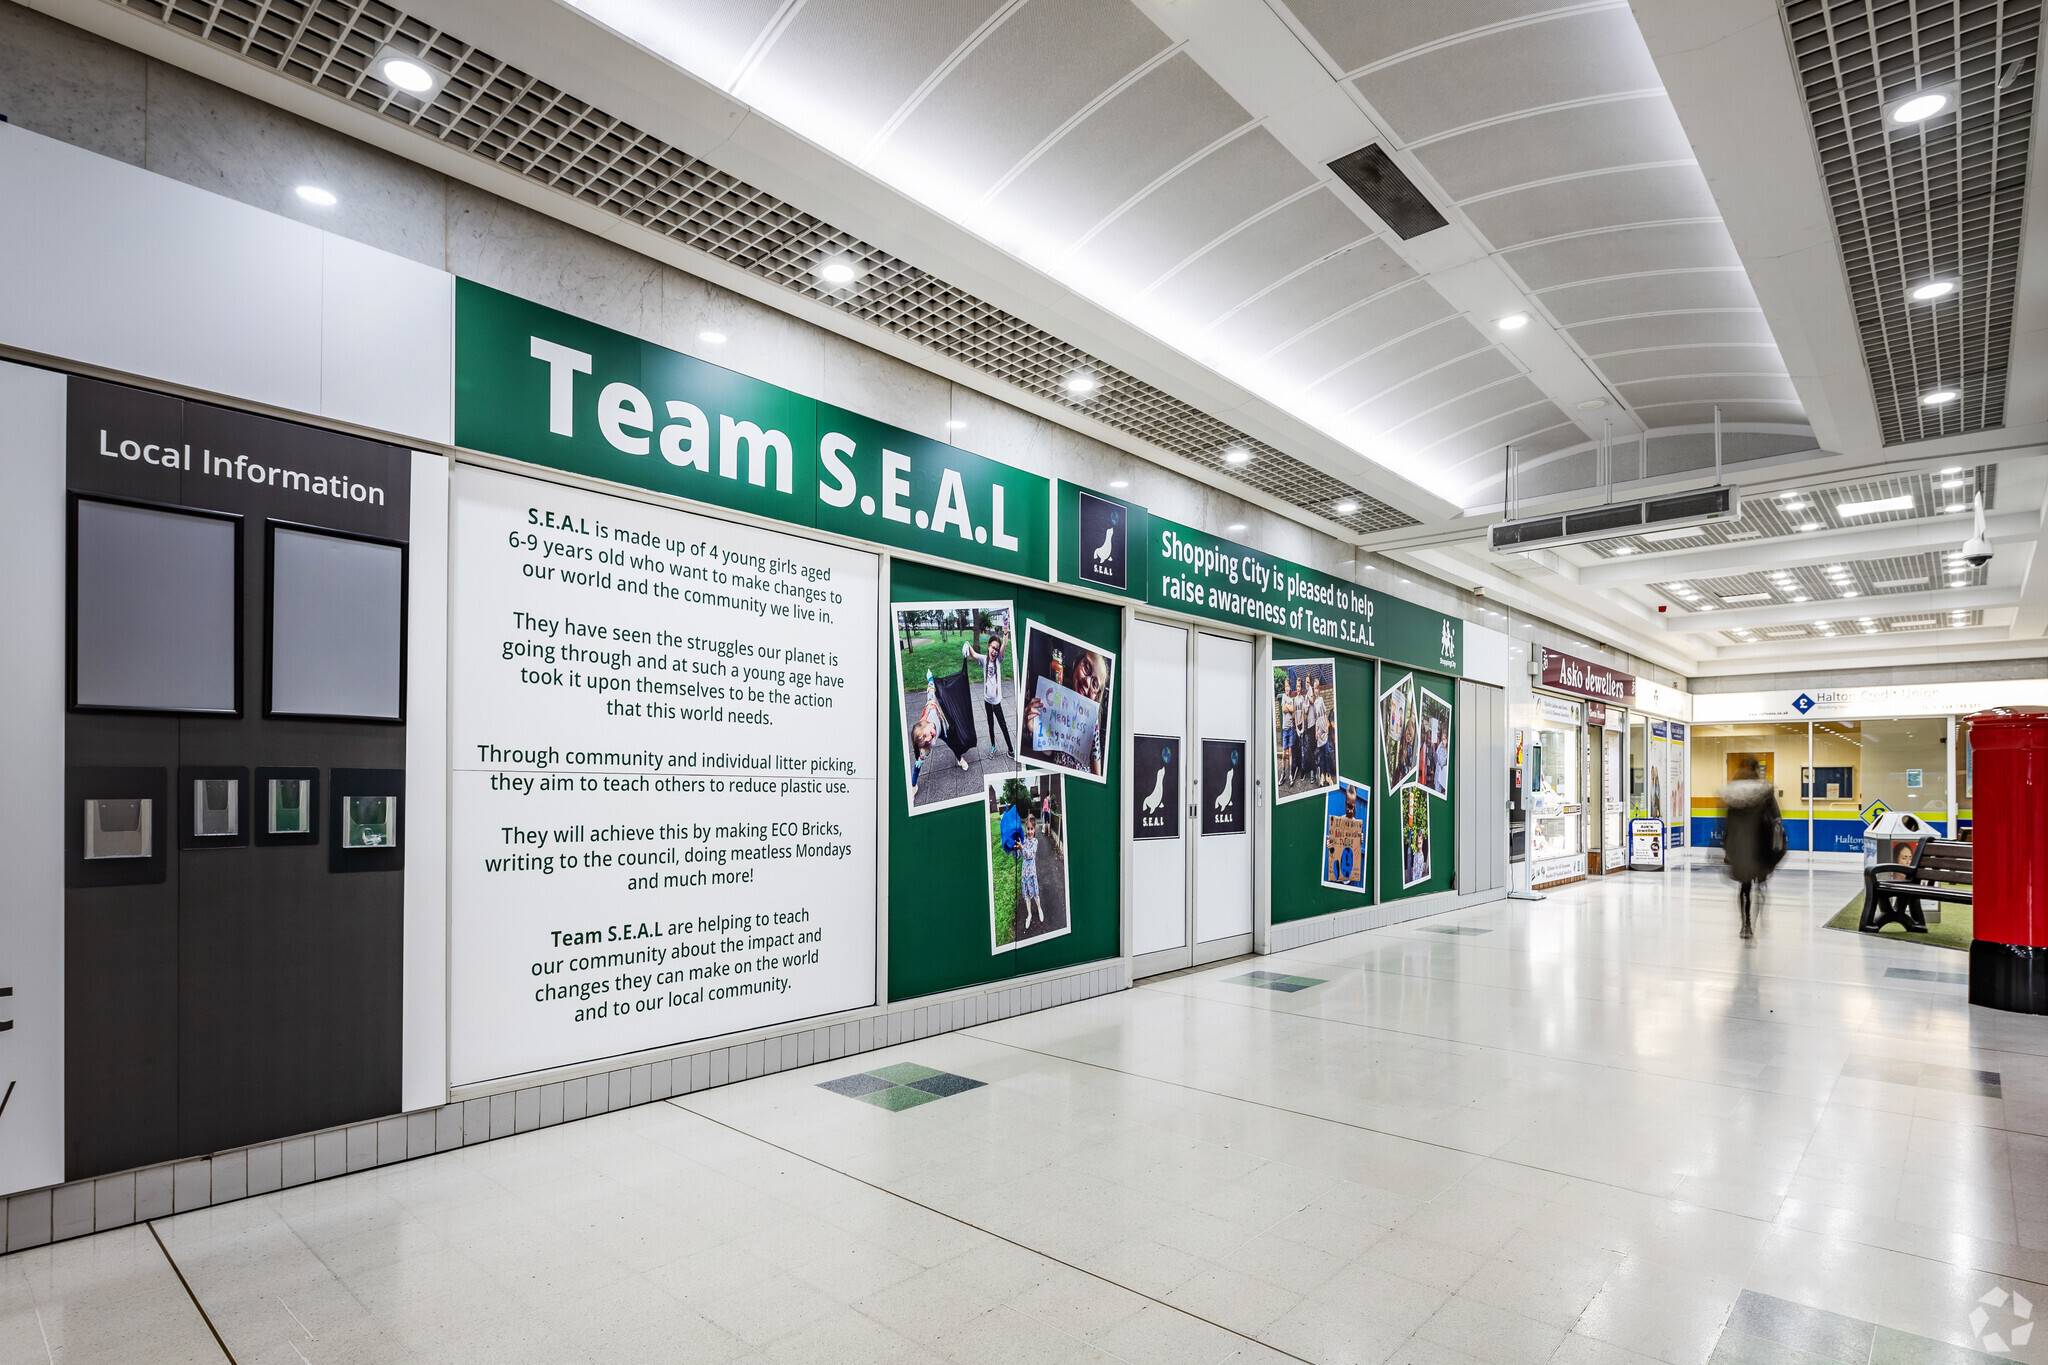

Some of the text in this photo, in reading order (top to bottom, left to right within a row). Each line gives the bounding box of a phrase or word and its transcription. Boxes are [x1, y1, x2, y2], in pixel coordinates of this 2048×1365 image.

[528, 333, 1021, 555] Team S.E.A.L
[99, 429, 385, 506] Local Information
[528, 507, 831, 583] S.E.A.L is made up of 4 young girls aged
[508, 530, 843, 605] 6-9 years old who want to make changes to
[1162, 530, 1374, 618] Shopping City is pleased to help
[522, 563, 834, 624] our world and the community we live in.
[1162, 574, 1374, 647] raise awareness of Team S.E.A.L
[512, 611, 839, 667] They have seen the struggles our planet is
[501, 639, 844, 689] going through and at such a young age have
[1585, 666, 1623, 698] Jewellers
[520, 667, 833, 708] took it upon themselves to be the action
[1817, 693, 1855, 702] Halton
[606, 698, 773, 726] that this world needs.
[476, 743, 857, 776] Through community and individual litter picking,
[490, 772, 851, 798] they aim to teach others to reduce plastic use.
[501, 820, 842, 849] They will achieve this by making ECO Bricks,
[1142, 816, 1164, 827] S.E.A.L
[1215, 814, 1233, 823] S.E.A.L
[484, 842, 852, 875] writing to the council, doing meatless Mondays
[627, 867, 754, 891] and much more!
[550, 907, 809, 948] Team S.E.A.L are helping to teach
[531, 927, 822, 977] our community about the impact and
[535, 948, 819, 1003] changes they can make on the world
[574, 976, 792, 1023] and to our local community.
